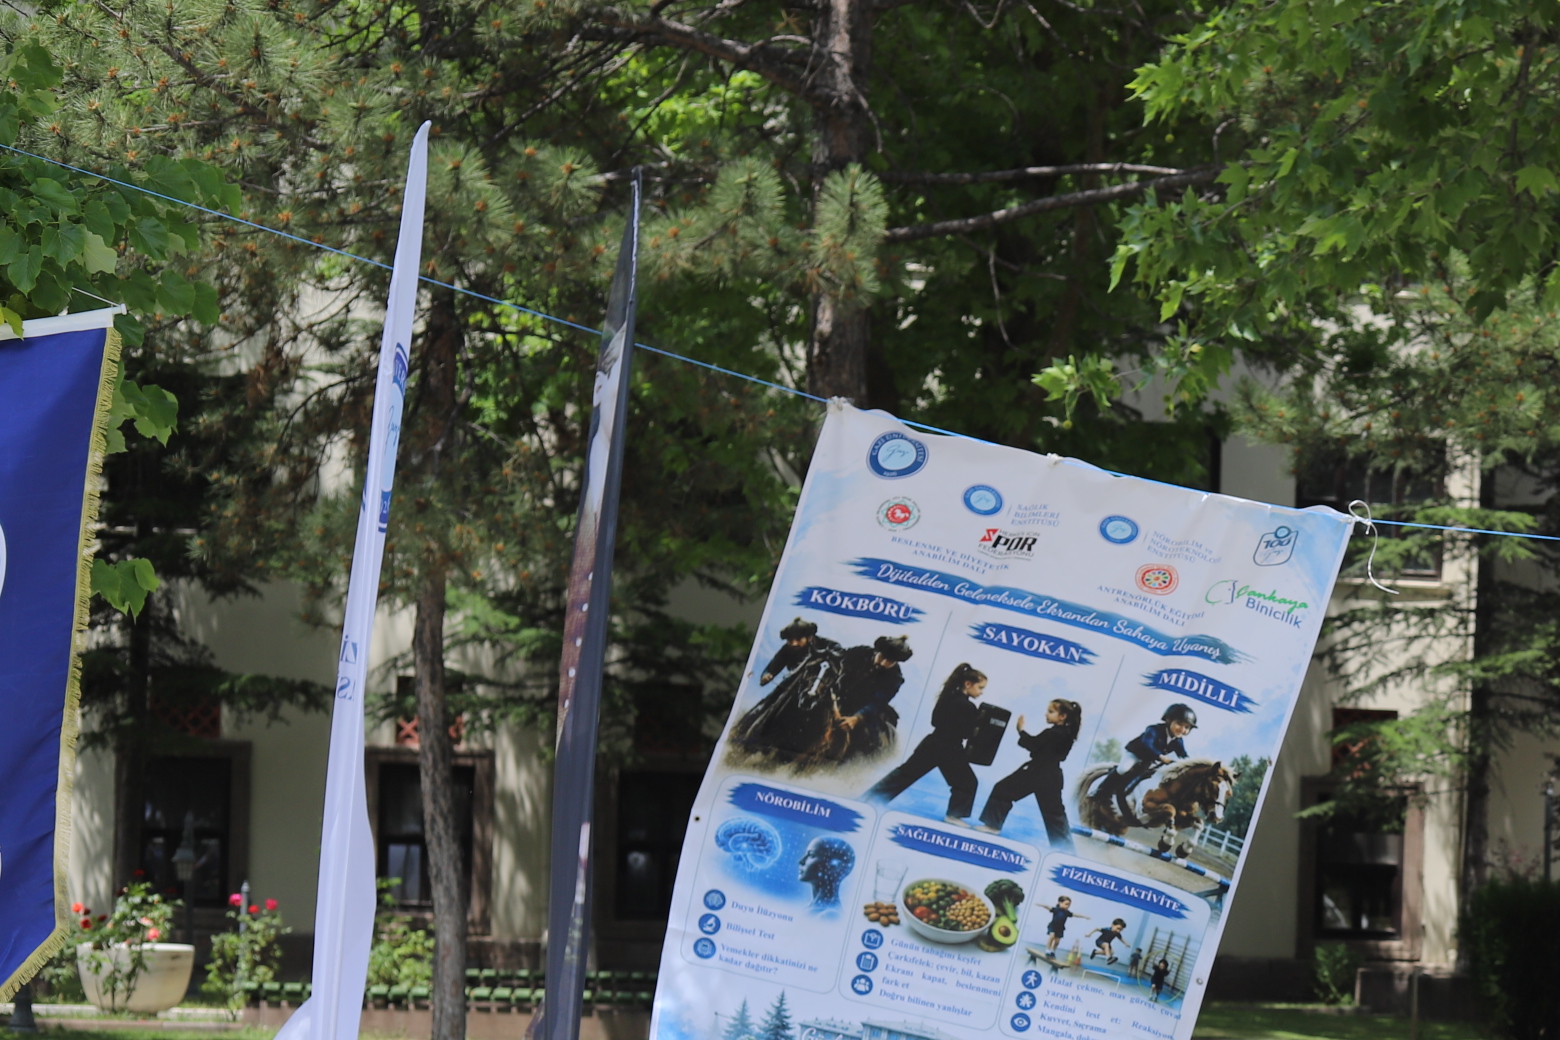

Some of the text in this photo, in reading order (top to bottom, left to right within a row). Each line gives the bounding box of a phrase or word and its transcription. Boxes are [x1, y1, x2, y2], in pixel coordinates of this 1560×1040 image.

[891, 535, 942, 553] BESLENME
[945, 548, 958, 557] VE
[979, 529, 1038, 551] SPOR
[912, 550, 961, 567] ANABİLİM
[962, 563, 987, 575] DALI
[809, 589, 914, 620] KÖKBÖRÜ
[877, 562, 950, 592] Dijitalden
[953, 582, 1034, 611] Geleneksele
[1036, 595, 1110, 629] Ekrandan
[1112, 619, 1169, 651] Sahaya
[1114, 597, 1186, 627] ANABİLİM DALI
[1245, 597, 1303, 630] Binicilik
[983, 626, 1084, 662] SAYOKAN
[1159, 671, 1240, 708] MİDİLLİ
[755, 791, 832, 818] NÖROBİLİM
[897, 825, 960, 849] SAĞLIKLI
[1061, 867, 1181, 912] FİZİKSEL AKTİVİTE
[731, 900, 755, 914] Duyu
[726, 922, 775, 940] Bilişsel Test
[890, 938, 920, 952] Günün
[718, 953, 779, 976] kadar dağıtır?
[720, 942, 819, 973] Yemekler dikkatinizi ne
[881, 976, 910, 989] fark et
[884, 963, 914, 977] Ekranı
[955, 979, 1002, 997] beslenmeni
[975, 970, 1001, 984] kazan
[1049, 976, 1073, 988] Halat
[879, 988, 906, 1003] Doğru
[907, 994, 936, 1009] bilinen
[1042, 1000, 1077, 1014] Kendini
[1085, 1010, 1101, 1020] test
